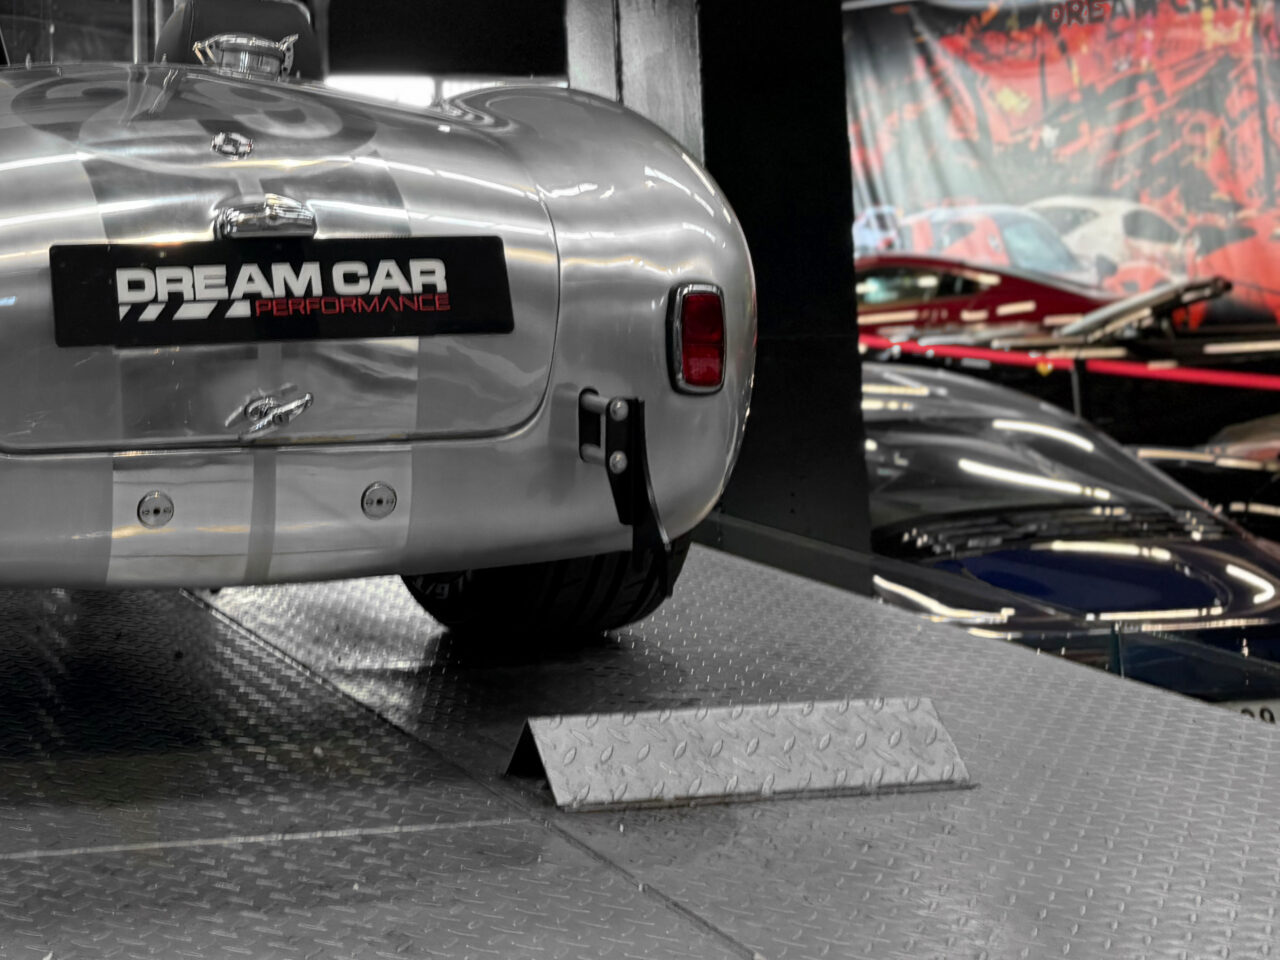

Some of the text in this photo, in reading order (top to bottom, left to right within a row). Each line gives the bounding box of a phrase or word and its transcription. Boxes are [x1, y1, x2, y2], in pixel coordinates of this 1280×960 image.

[116, 258, 448, 304] DREAM CAR
[255, 292, 451, 318] PERFORMANCE
